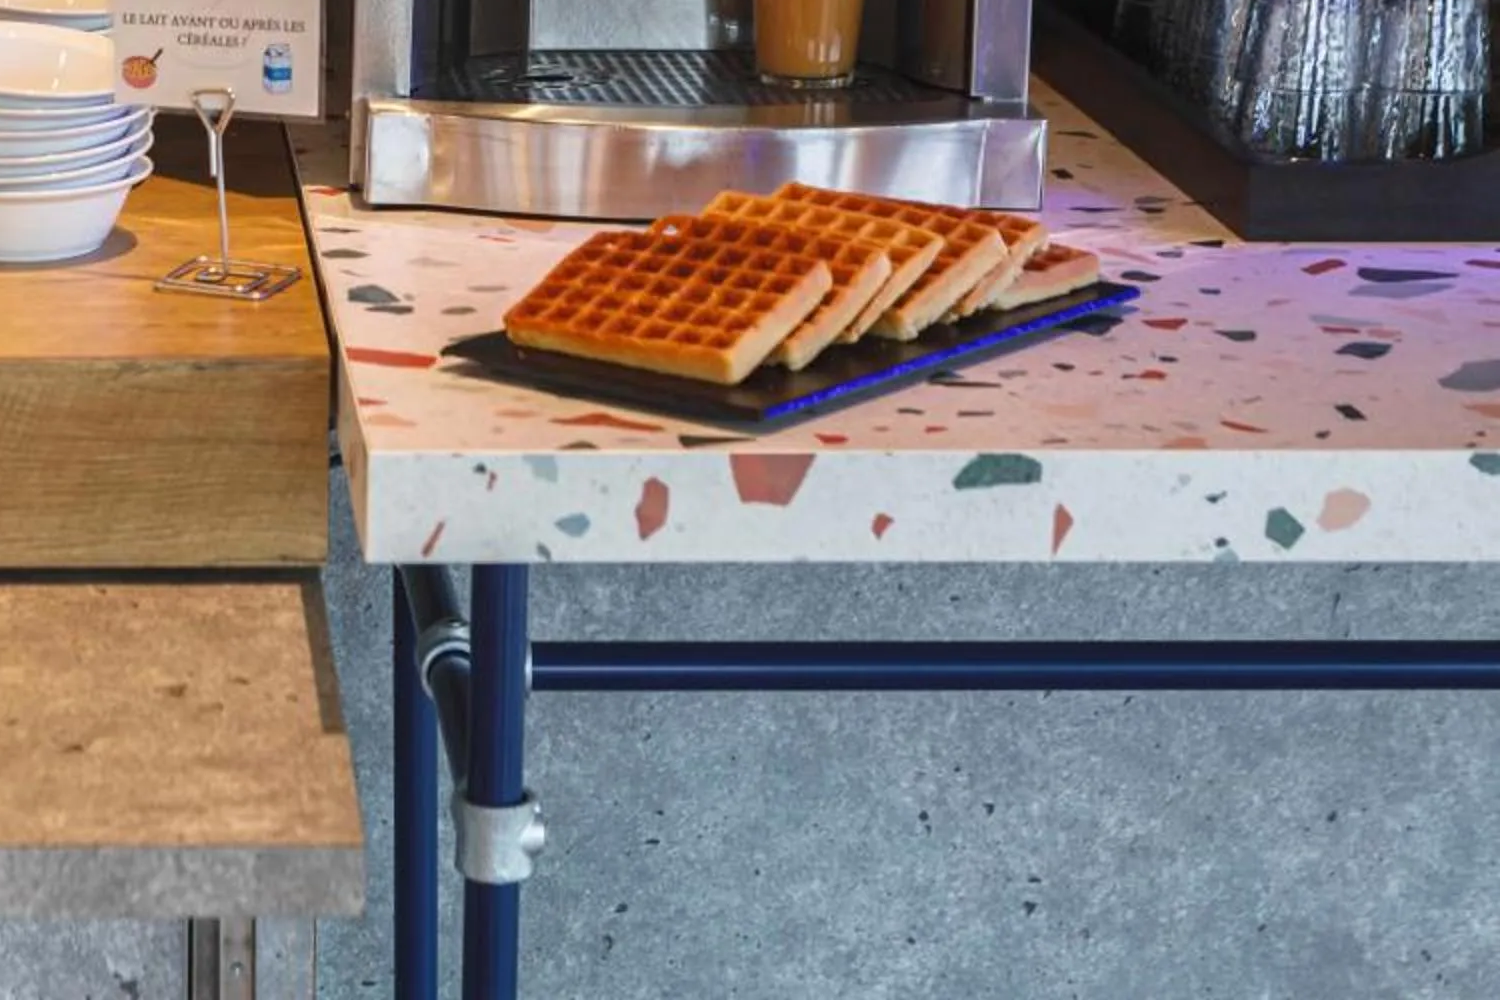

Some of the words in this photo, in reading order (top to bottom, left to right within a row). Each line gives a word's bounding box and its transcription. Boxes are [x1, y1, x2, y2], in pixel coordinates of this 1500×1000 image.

[122, 13, 136, 25] LE
[139, 14, 168, 26] LAIT
[219, 17, 240, 30] OU
[283, 19, 306, 32] LES
